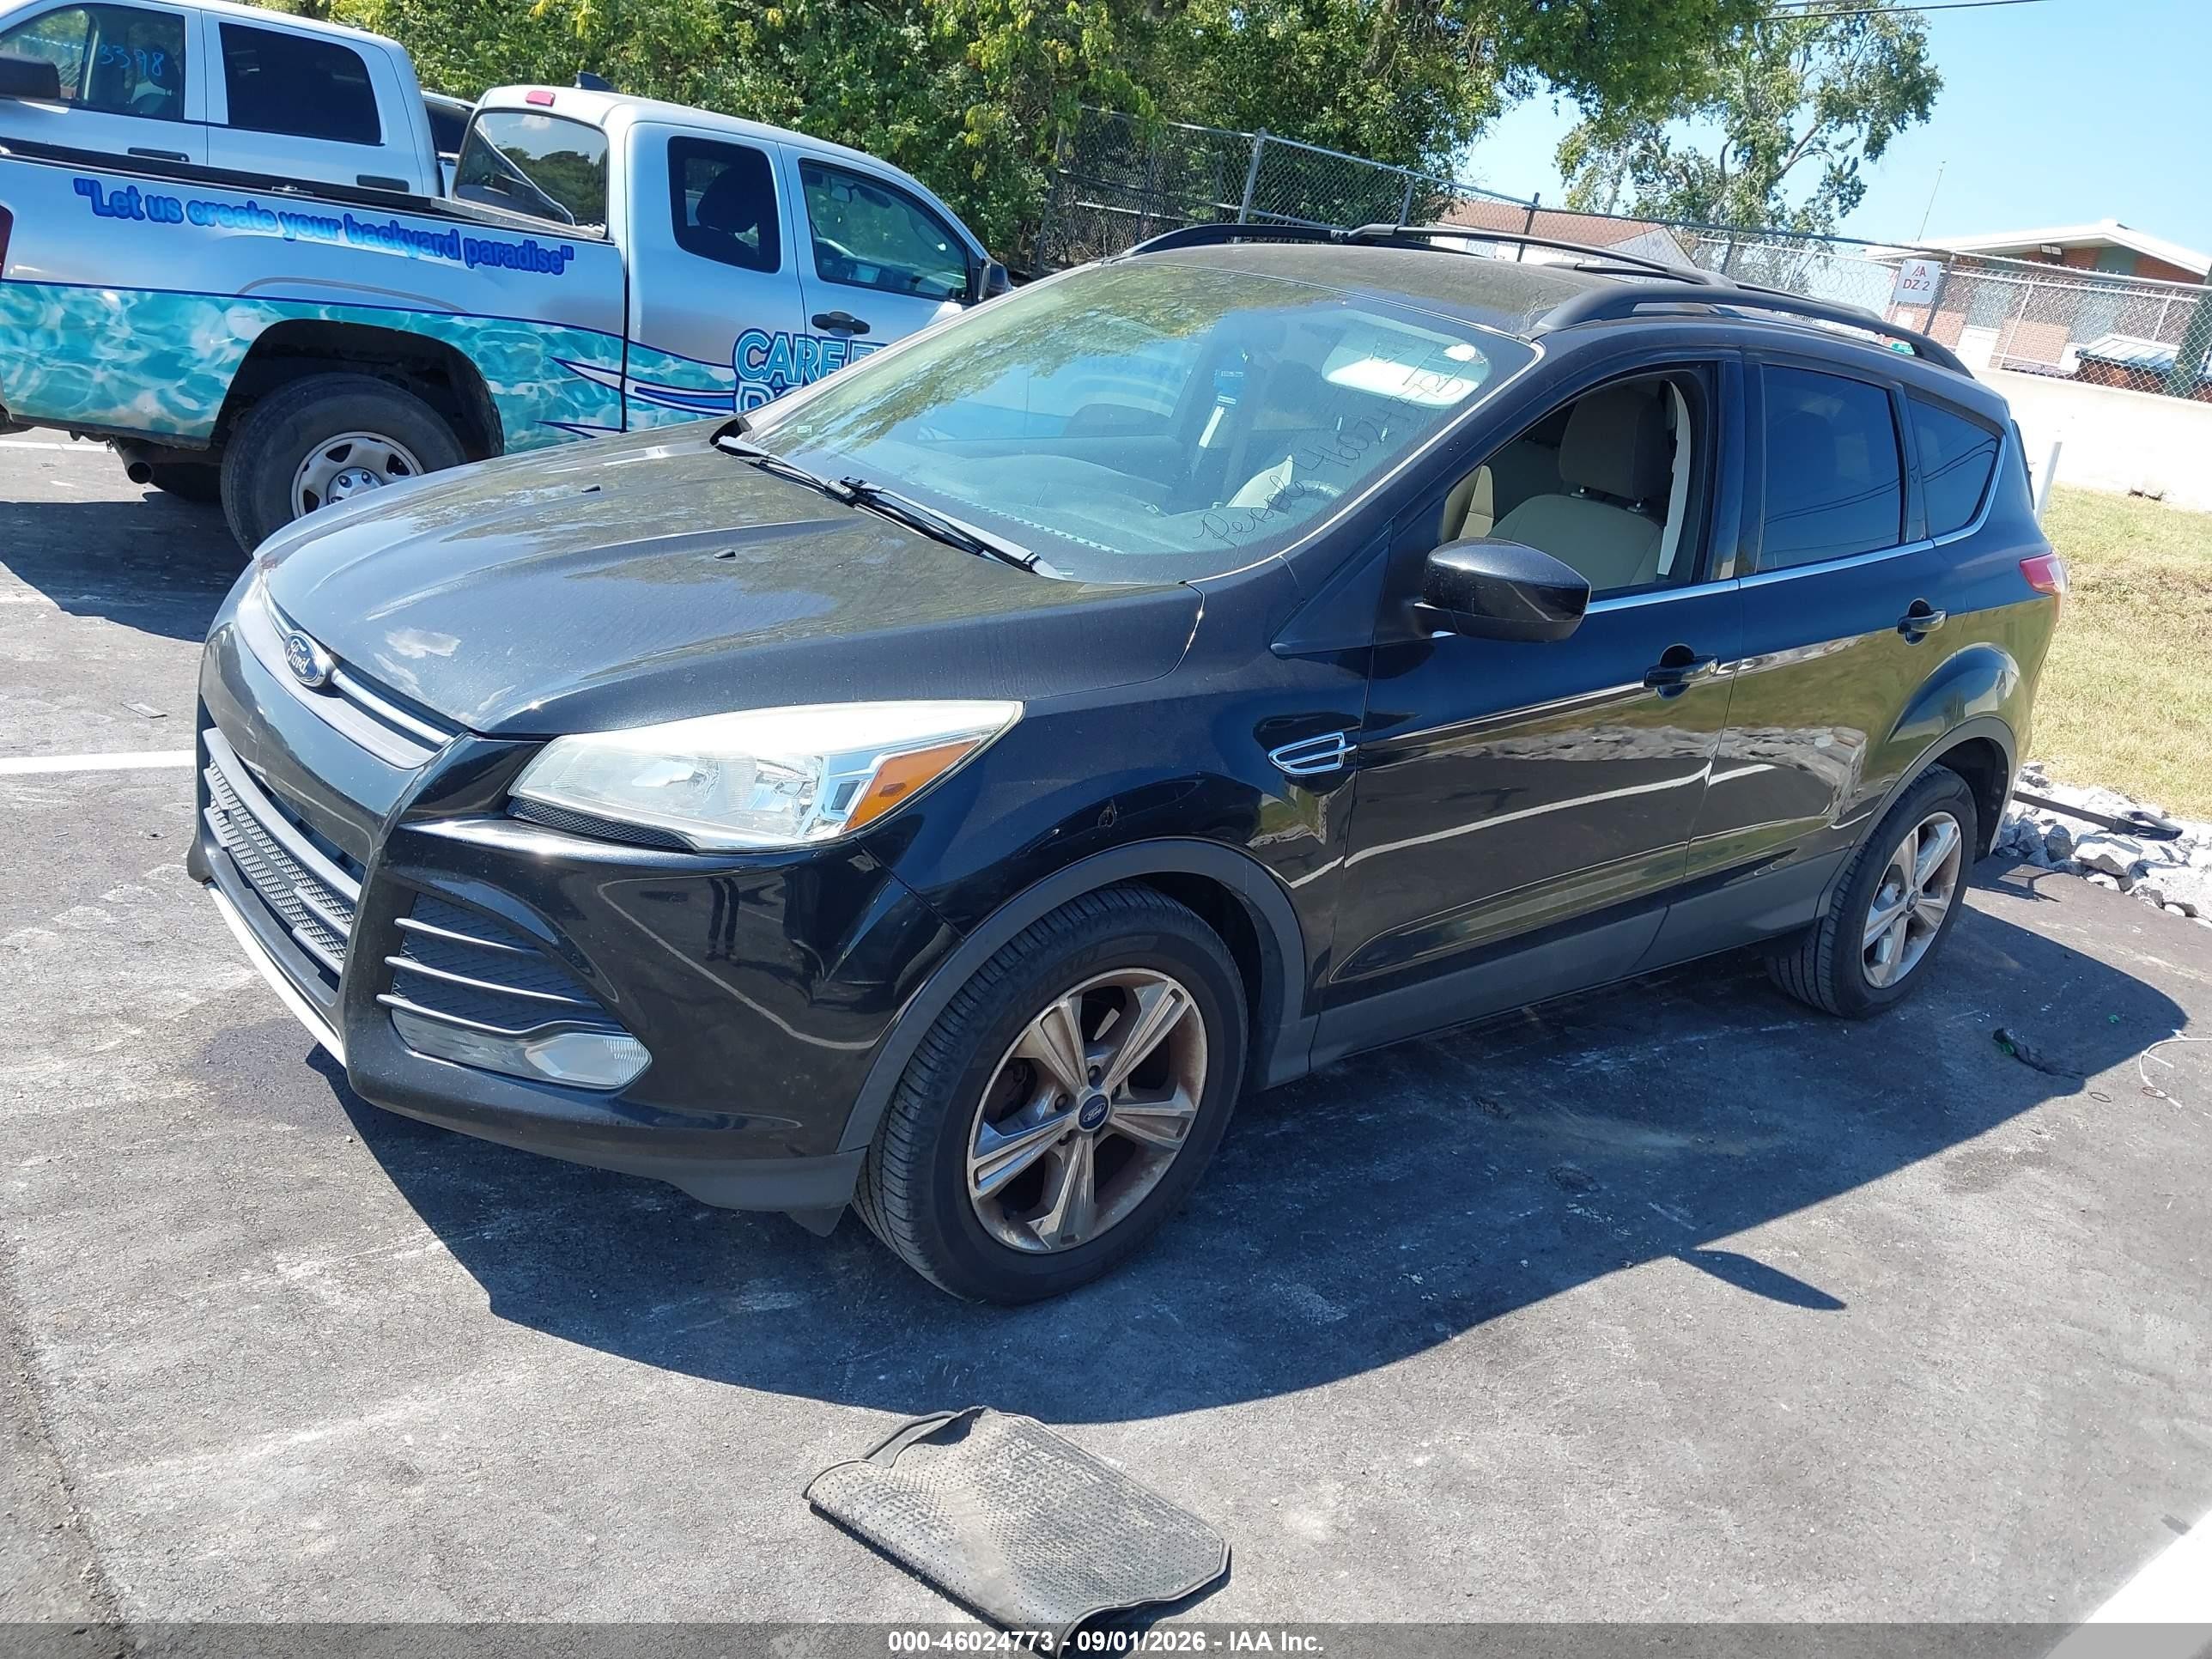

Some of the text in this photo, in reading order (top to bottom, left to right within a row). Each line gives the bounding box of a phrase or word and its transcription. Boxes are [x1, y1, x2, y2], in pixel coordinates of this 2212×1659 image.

[73, 177, 574, 276] "Let us create your backyard paradise"
[1903, 278, 1930, 290] DZ 2
[286, 638, 310, 675] Ford
